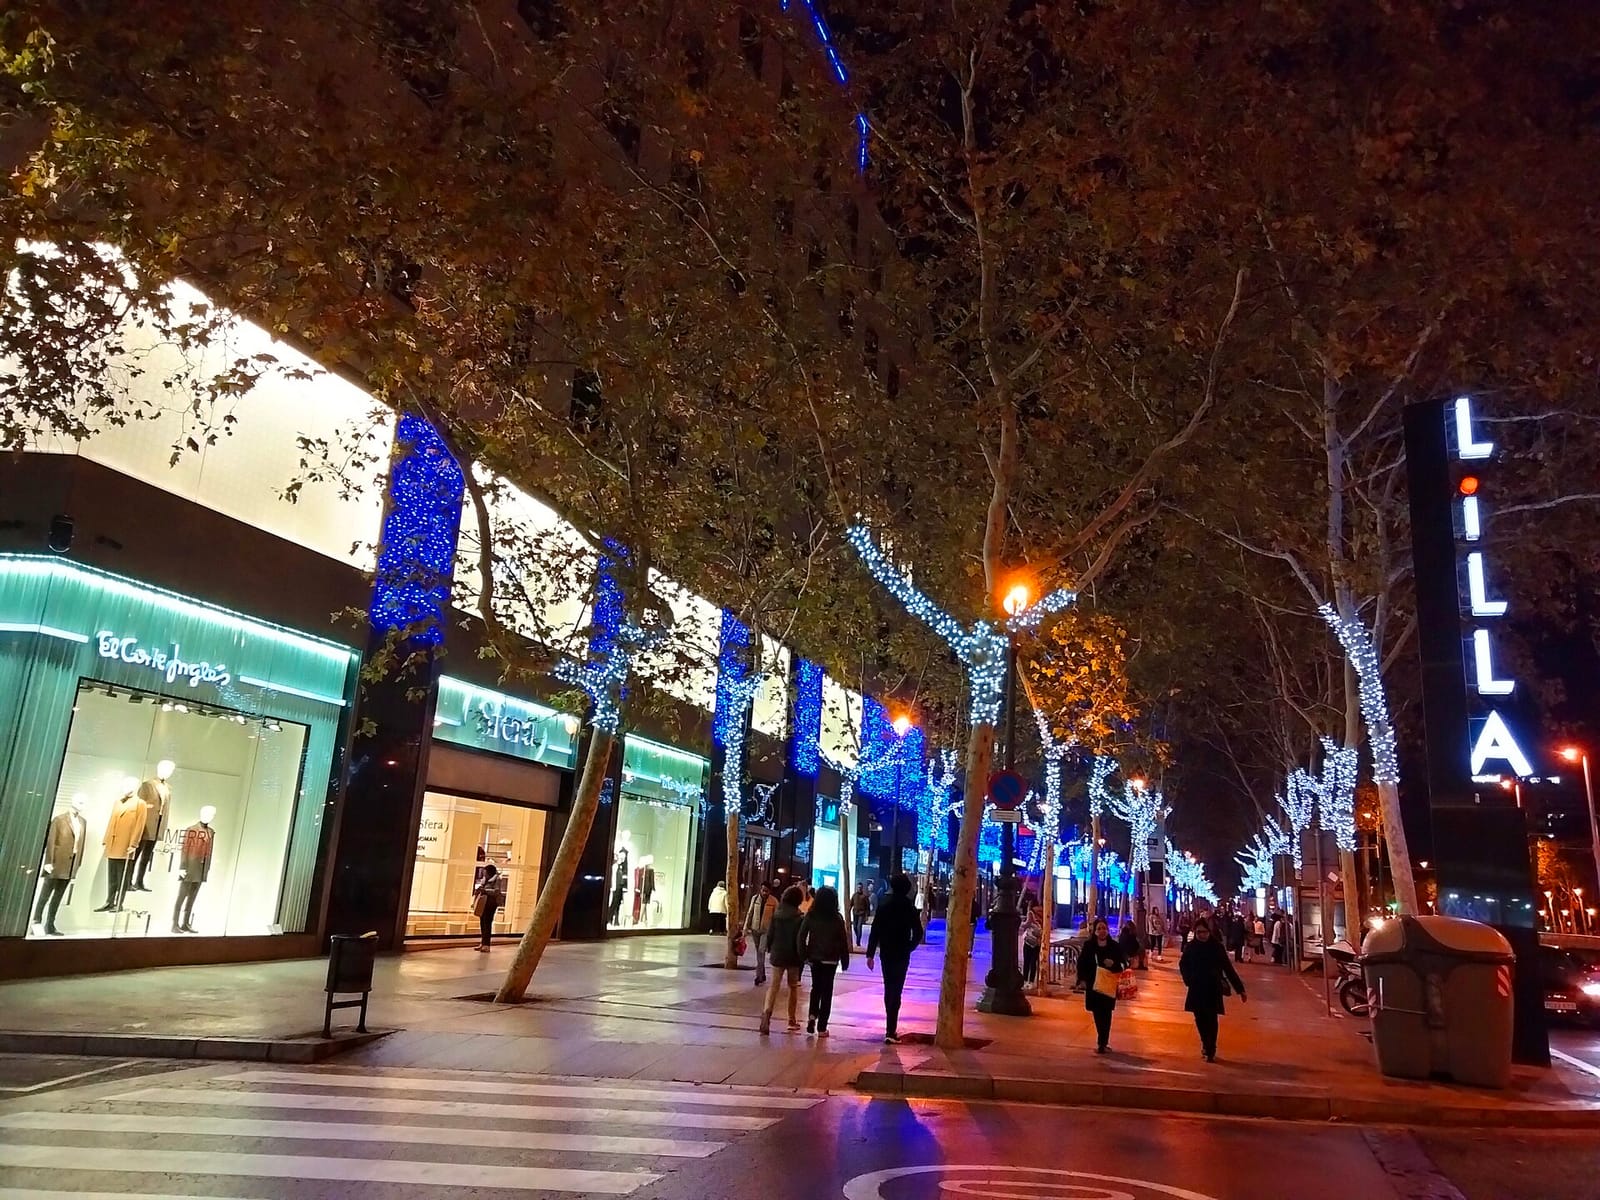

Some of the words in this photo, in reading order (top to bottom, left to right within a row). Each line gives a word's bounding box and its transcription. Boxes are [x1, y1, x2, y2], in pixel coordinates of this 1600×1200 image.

[96, 630, 120, 659] El
[120, 638, 167, 670] Corte
[166, 642, 232, 688] Inglés
